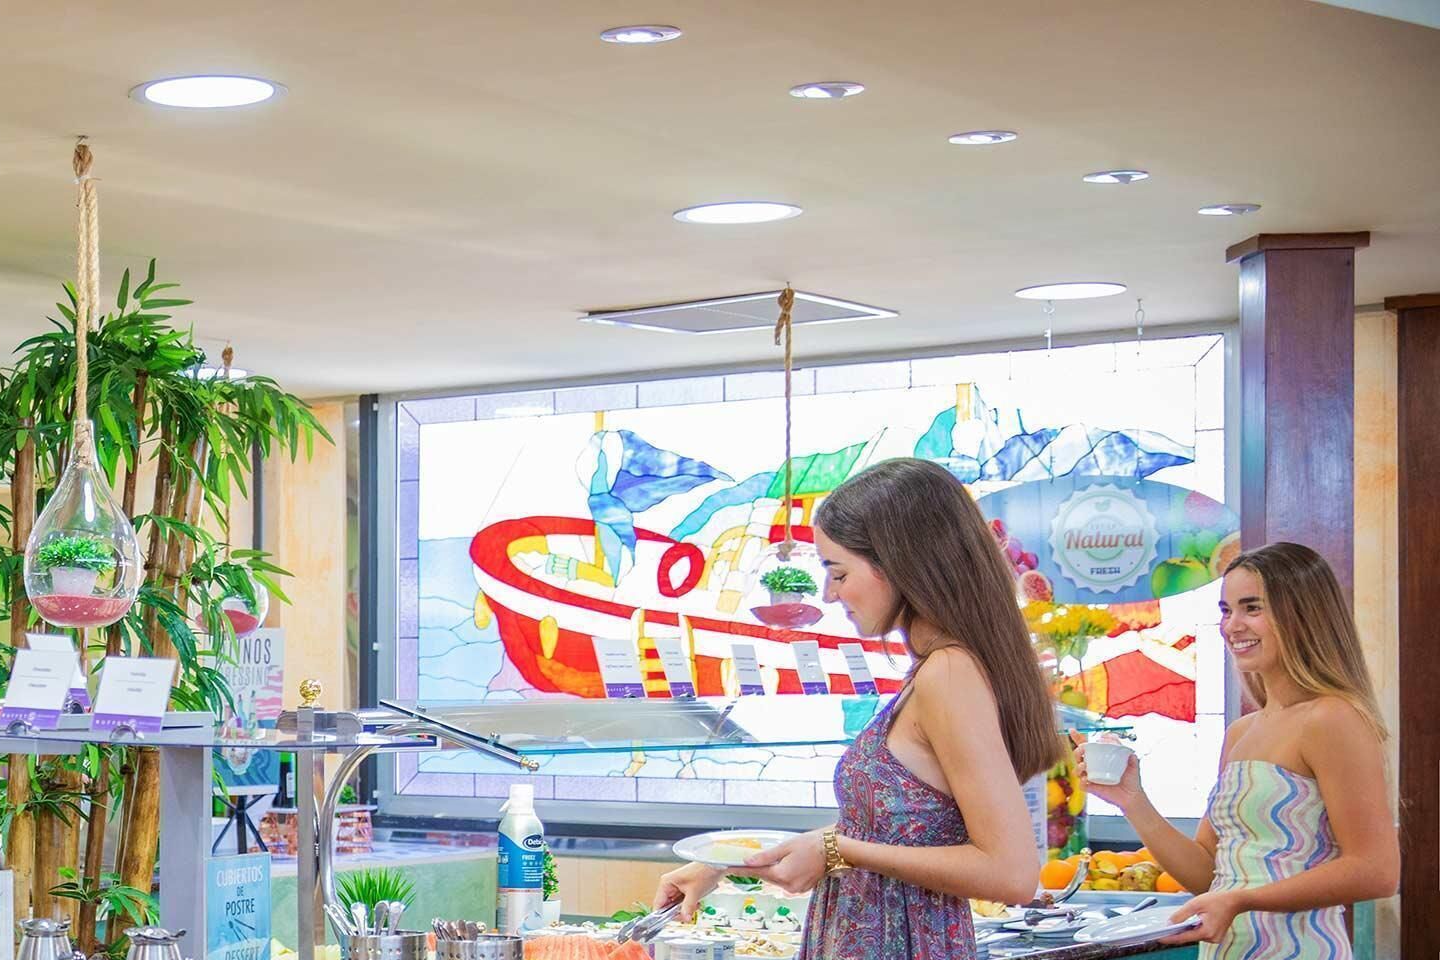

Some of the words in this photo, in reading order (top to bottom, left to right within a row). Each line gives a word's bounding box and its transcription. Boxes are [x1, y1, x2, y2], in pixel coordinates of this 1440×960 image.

[1064, 528, 1145, 550] Natural
[216, 865, 264, 887] CUBIERTOS
[236, 886, 244, 897] DE
[226, 898, 255, 916] POSTRE
